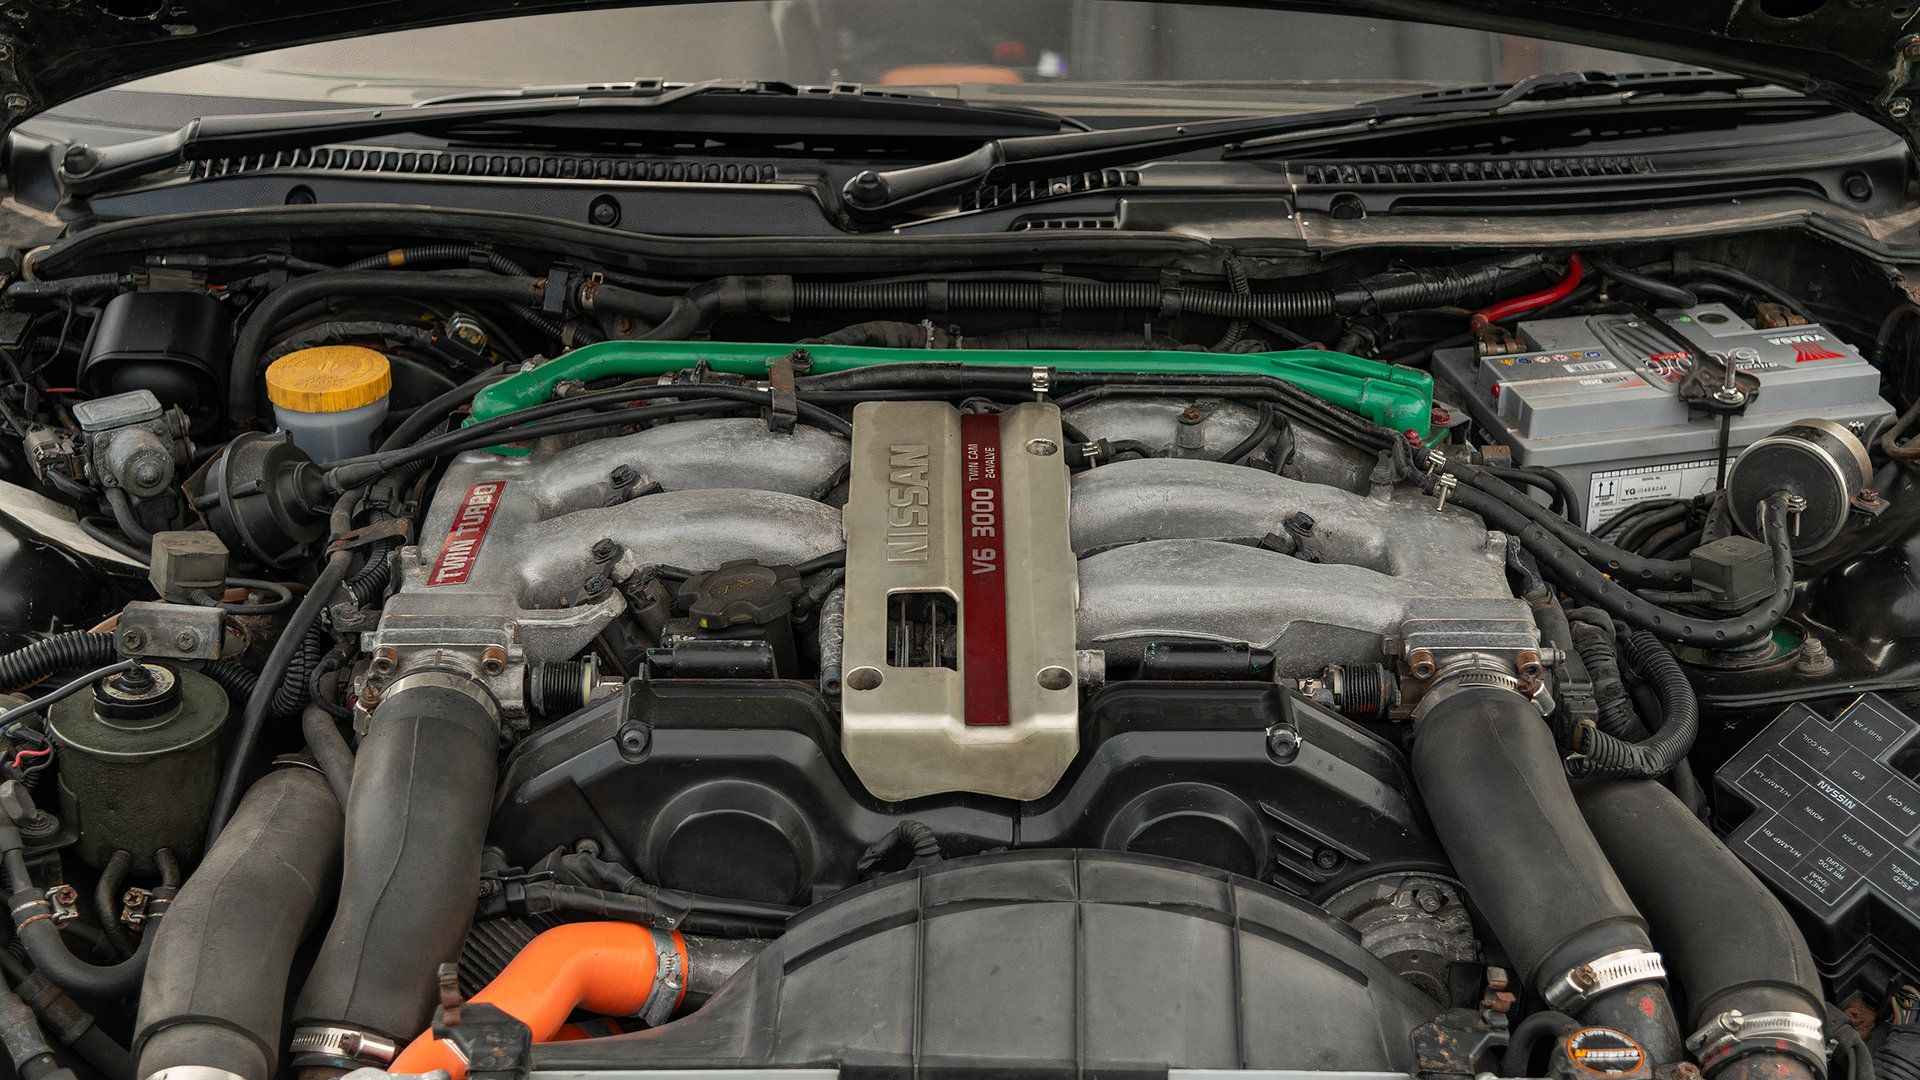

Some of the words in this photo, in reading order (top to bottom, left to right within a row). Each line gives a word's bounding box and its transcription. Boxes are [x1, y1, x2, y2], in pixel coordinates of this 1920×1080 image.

[1768, 335, 1827, 345] YUASA
[968, 443, 979, 458] CAM
[985, 447, 996, 480] 24VALVE
[968, 462, 979, 482] TWIN
[455, 485, 498, 537] TURBO
[888, 444, 929, 563] NISSAN
[971, 487, 995, 538] 3000
[435, 539, 477, 582] TWIN
[972, 548, 997, 575] V6
[1853, 719, 1869, 732] FAN
[1802, 733, 1817, 747] COIL
[1868, 728, 1884, 742] SUB
[1815, 742, 1830, 756] IGN
[1753, 769, 1765, 780] LH
[1852, 770, 1865, 781] EGI
[1764, 776, 1792, 797] H/LAMP
[1817, 780, 1856, 809] NISSAN
[1886, 794, 1903, 807] CON
[1804, 806, 1825, 822] HORN
[1902, 804, 1916, 816] AIR
[1763, 827, 1777, 839] RH
[1841, 833, 1859, 847] FAN
[1775, 837, 1802, 858] H/LAMP
[1857, 844, 1873, 858] RAD
[1818, 859, 1834, 872] FOG
[1825, 856, 1847, 872] (EUR)
[1809, 870, 1830, 887] (USA)
[1891, 863, 1919, 886] CANCEL
[1802, 874, 1826, 894] THEFT
[1892, 876, 1915, 891] ASCD
